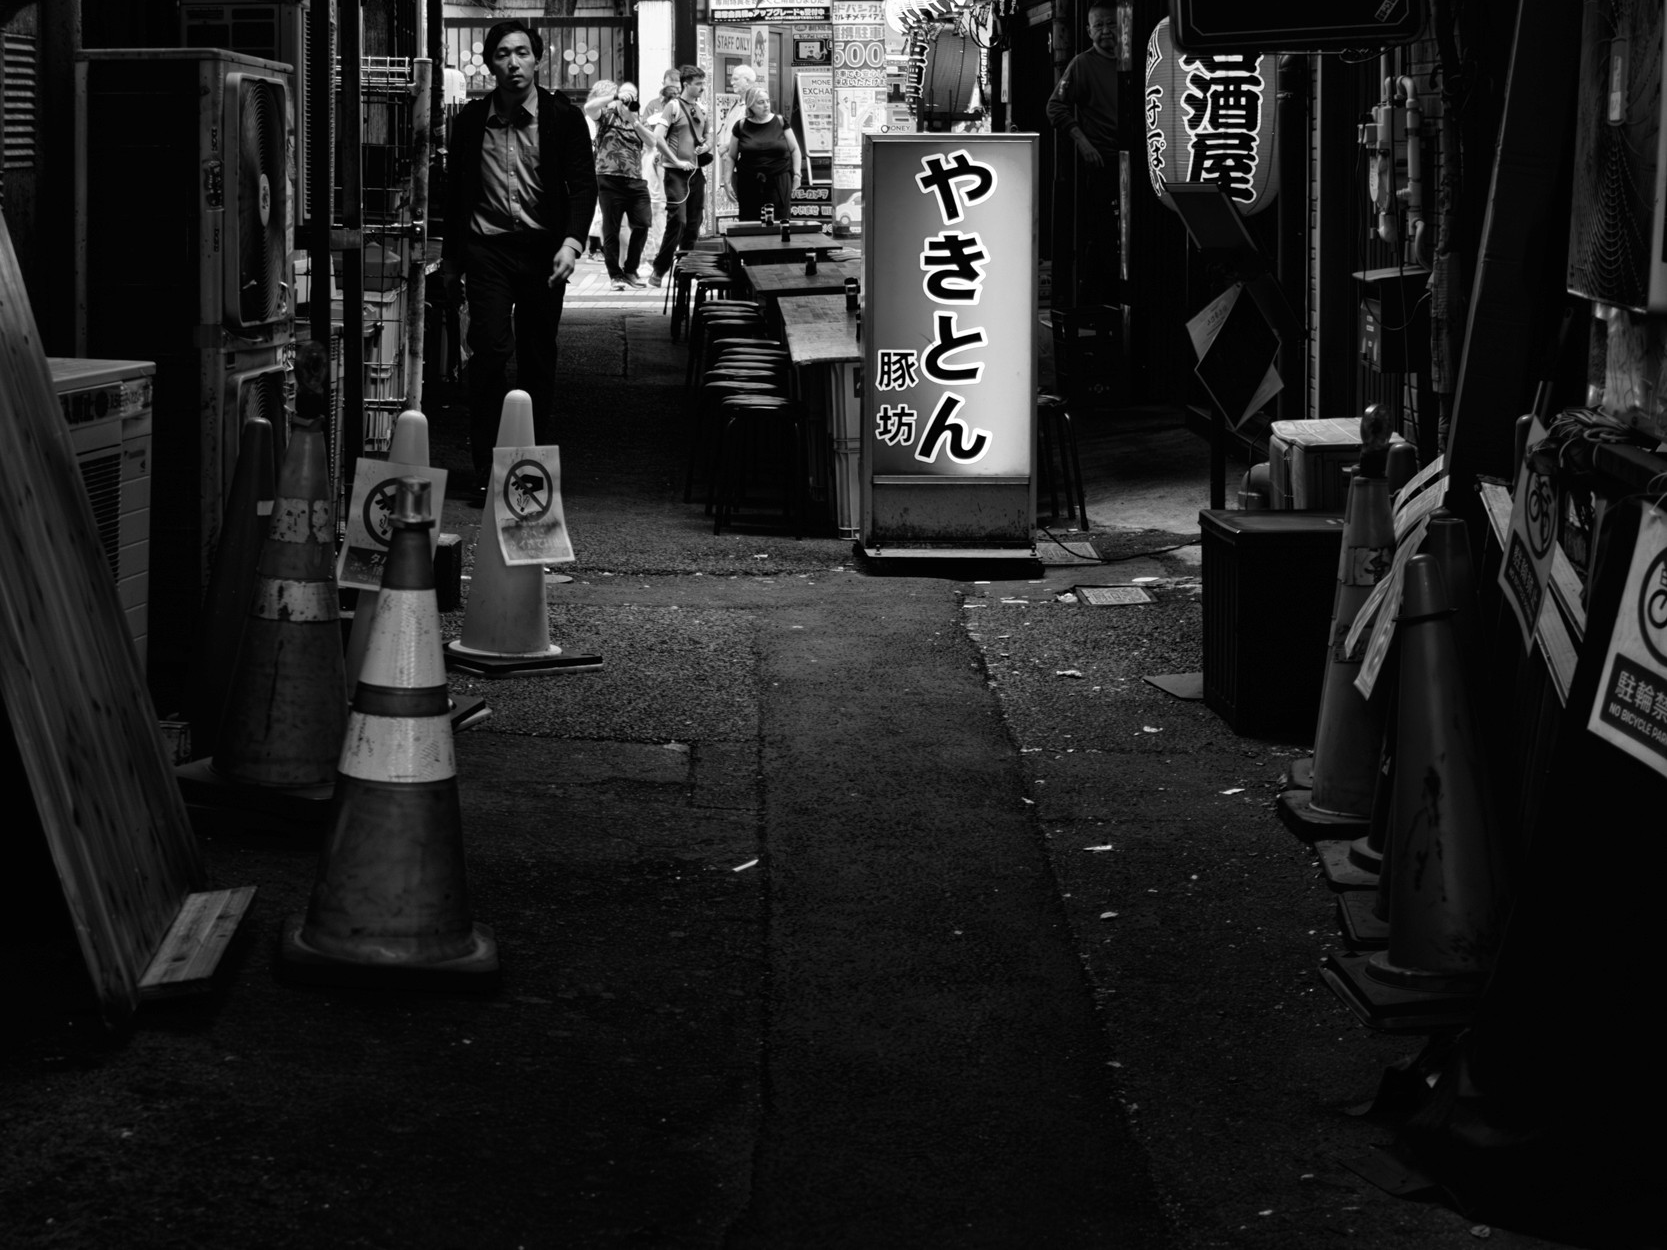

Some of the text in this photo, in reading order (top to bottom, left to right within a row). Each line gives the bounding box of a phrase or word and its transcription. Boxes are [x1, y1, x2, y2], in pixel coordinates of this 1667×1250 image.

[717, 35, 751, 51] STAFF ONLY
[916, 150, 997, 463] やきとん
[876, 350, 918, 447] 豚坊
[1609, 702, 1621, 717] NO
[1620, 708, 1653, 736] BICYCLE
